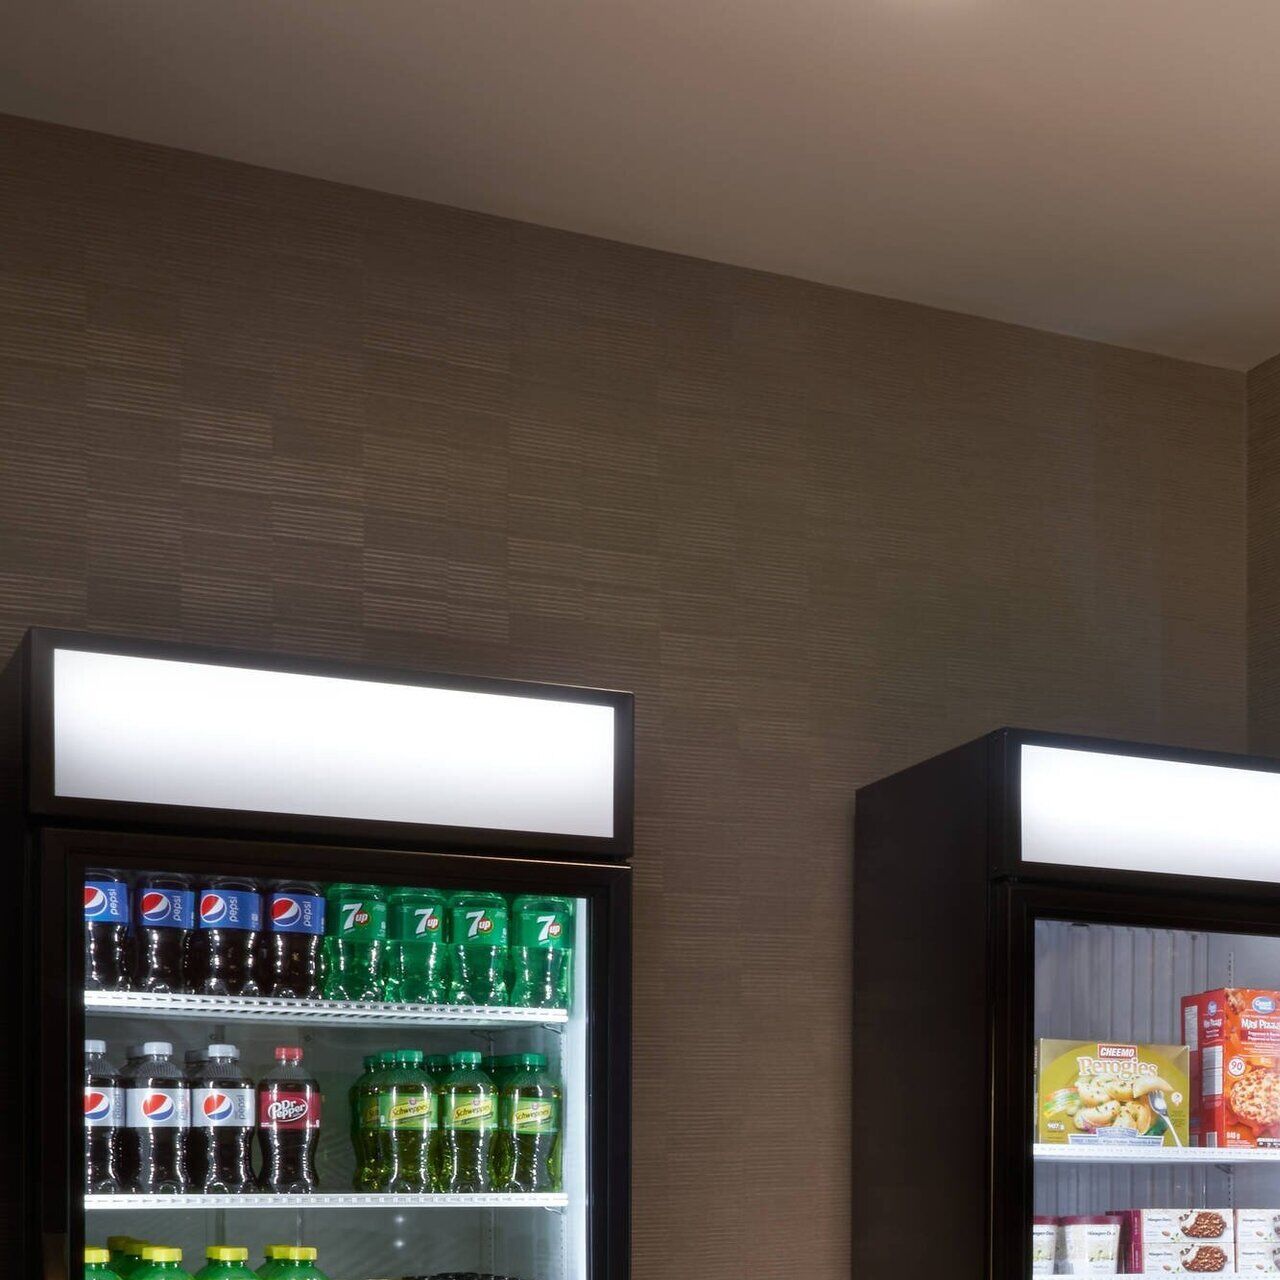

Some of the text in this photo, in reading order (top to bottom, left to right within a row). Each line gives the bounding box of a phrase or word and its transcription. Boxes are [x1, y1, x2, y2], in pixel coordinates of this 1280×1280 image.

[109, 888, 119, 915] pepsi
[172, 895, 182, 922] pepsi
[229, 896, 238, 923] pepsi
[302, 900, 312, 927] pepsi
[1100, 1047, 1135, 1058] CHEEMO
[1076, 1056, 1158, 1078] Perogies
[271, 1102, 307, 1120] Pepper
